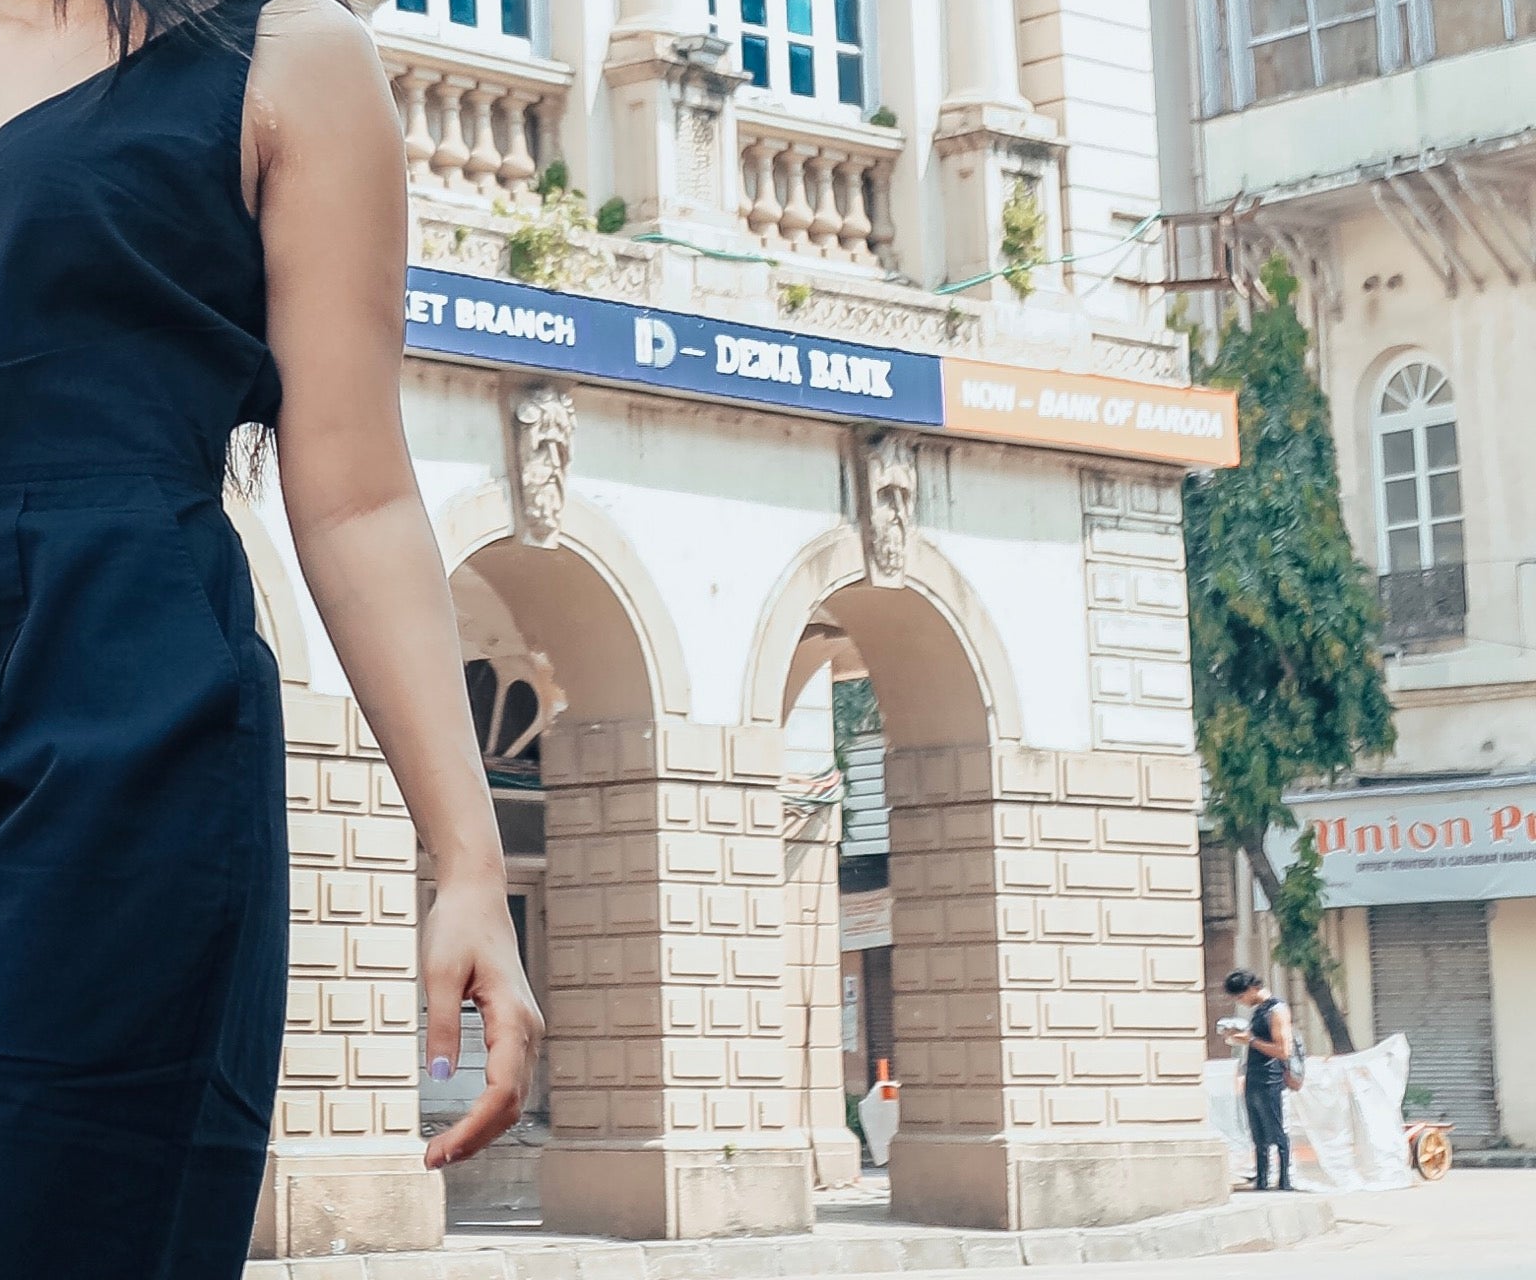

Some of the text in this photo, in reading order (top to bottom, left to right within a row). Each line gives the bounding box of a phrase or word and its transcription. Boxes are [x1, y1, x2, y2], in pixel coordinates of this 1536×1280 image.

[455, 298, 576, 346] BRANCH
[714, 334, 803, 385] DENA
[807, 349, 894, 398] BANK
[961, 379, 1016, 412] NOW
[1037, 388, 1102, 424] BANK
[1102, 397, 1135, 426] OF
[1135, 402, 1223, 439] BARODA
[1313, 816, 1472, 855] Union
